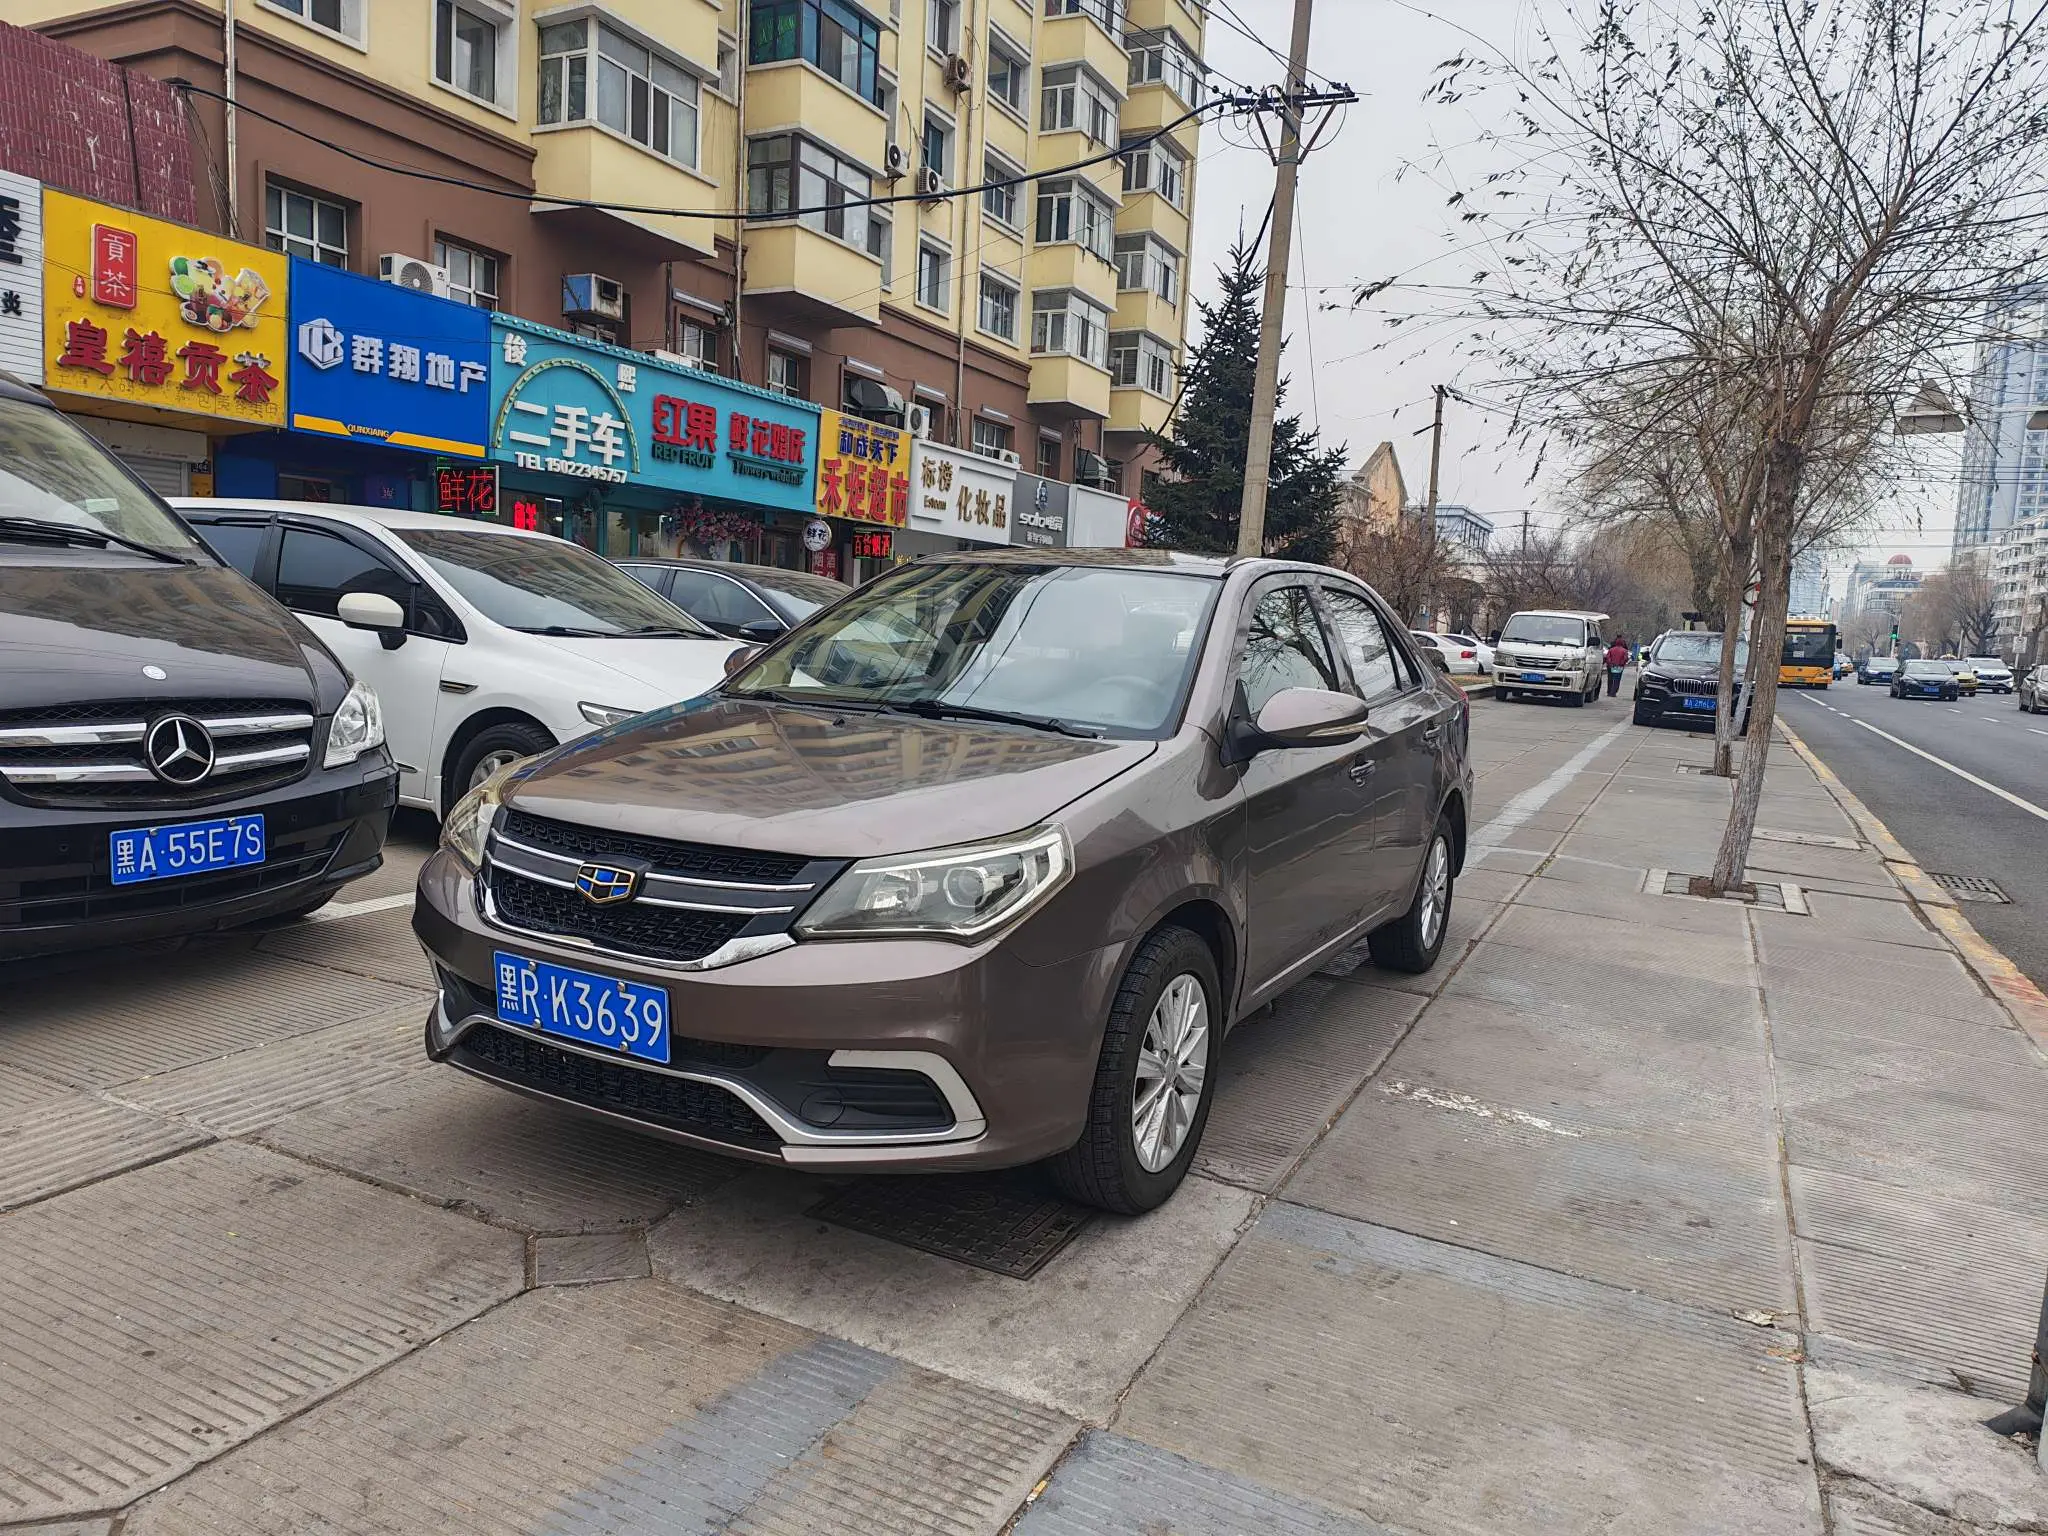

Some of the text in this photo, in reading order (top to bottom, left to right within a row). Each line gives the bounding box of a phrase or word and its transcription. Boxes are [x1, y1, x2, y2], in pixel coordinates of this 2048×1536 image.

[100, 233, 131, 297] 貢茶
[56, 317, 280, 402] 皇禧贡茶
[352, 334, 487, 393] 群翔地产
[347, 423, 390, 439] QUNXIANG
[509, 400, 626, 466] 二手车
[653, 393, 718, 453] 红果
[514, 451, 628, 484] TEL 15022345757
[680, 449, 716, 469] FRUIT
[921, 455, 953, 493] 标榜
[438, 469, 494, 513] 鲜花
[956, 485, 1006, 529] 化妆品
